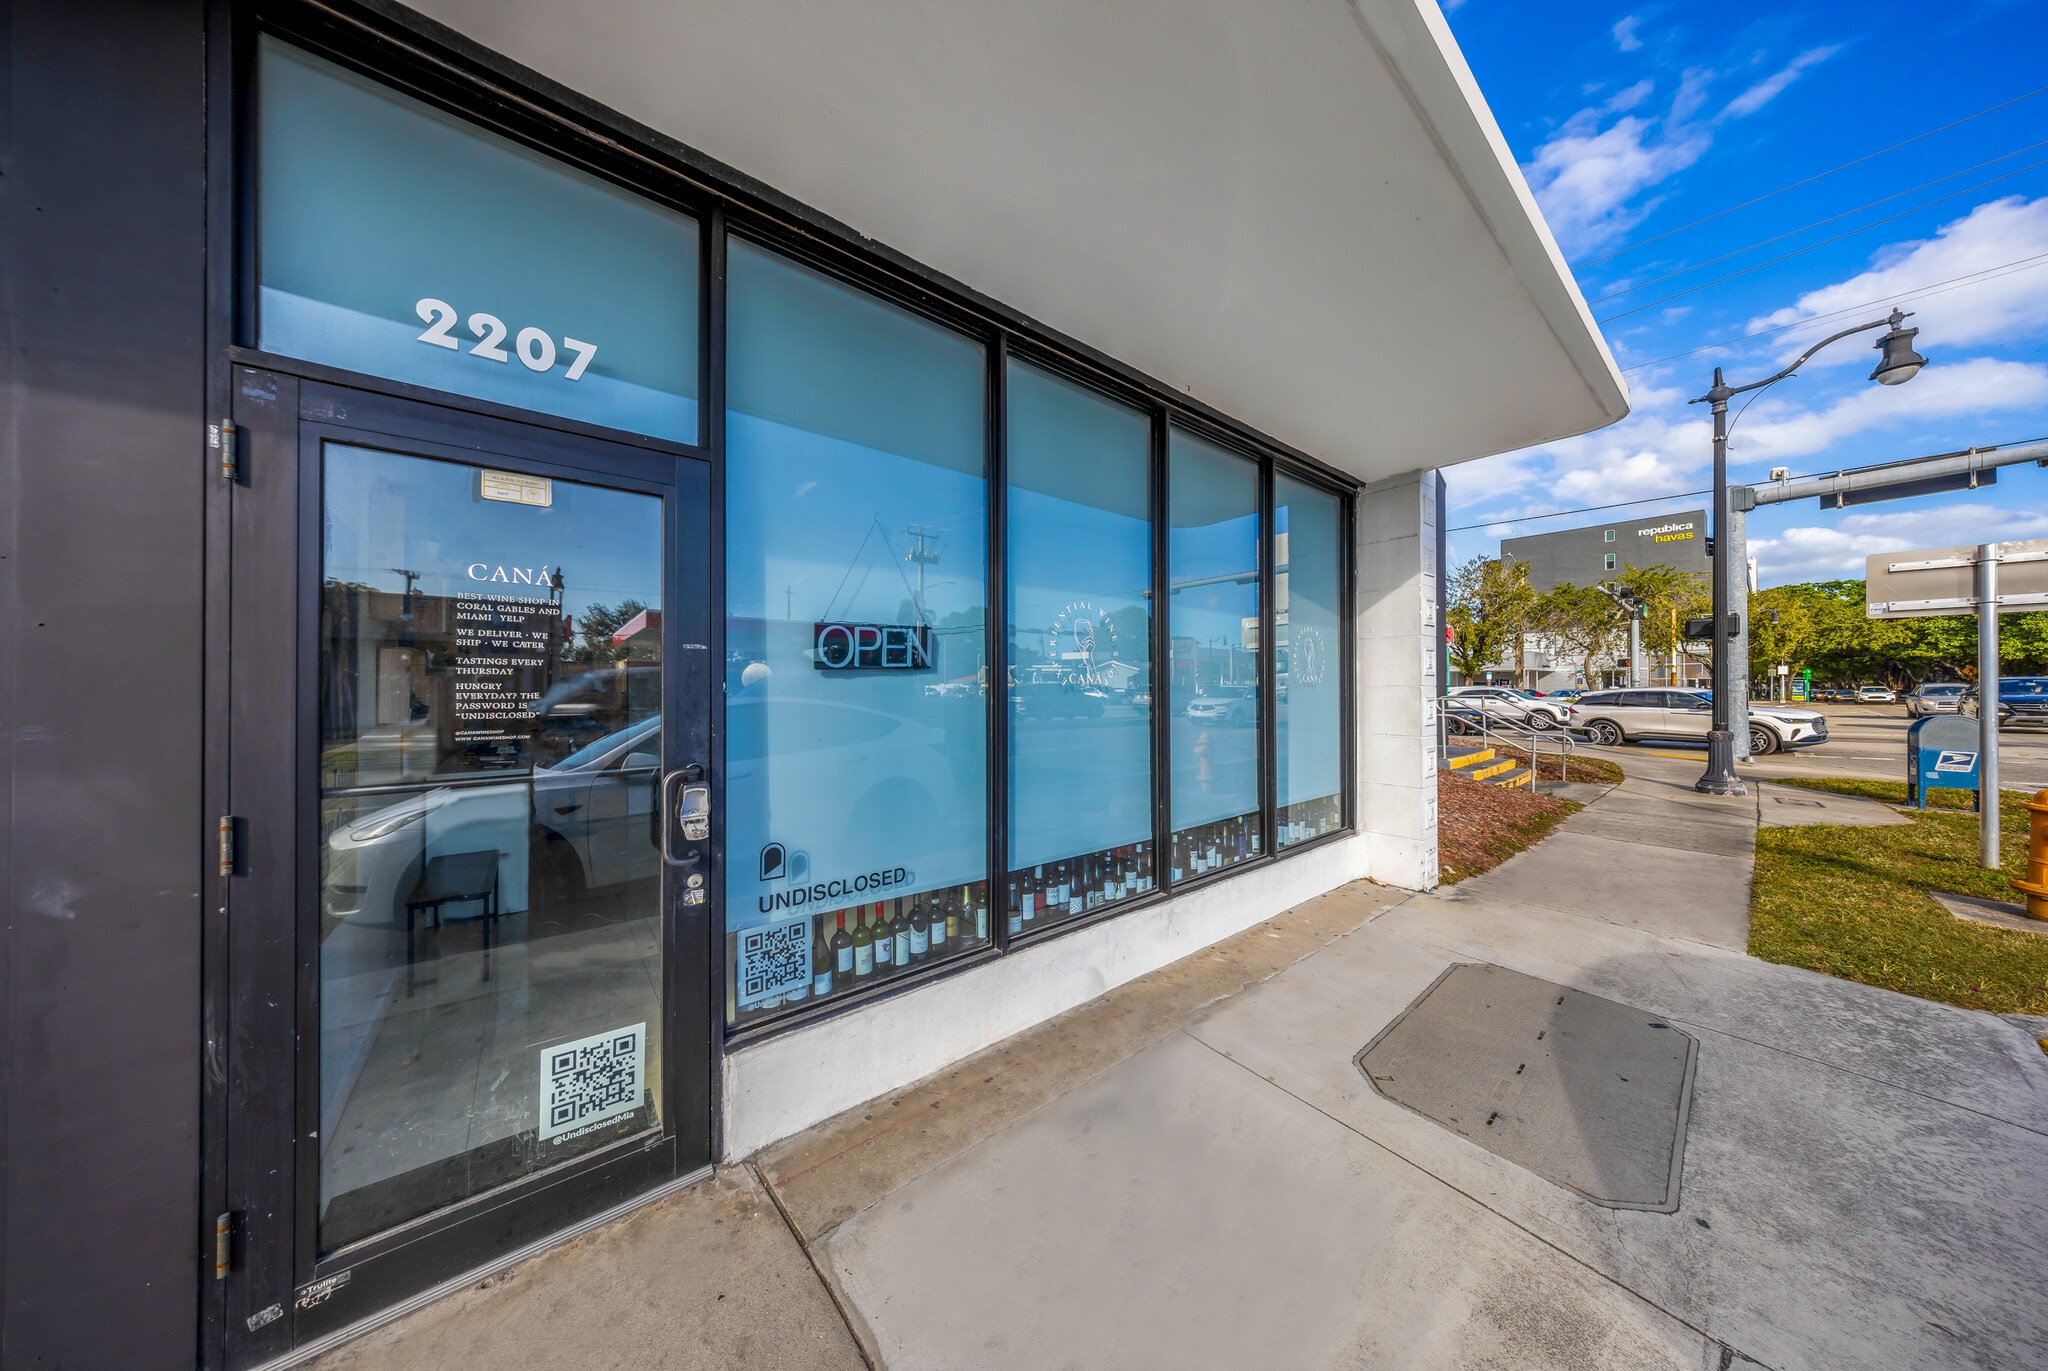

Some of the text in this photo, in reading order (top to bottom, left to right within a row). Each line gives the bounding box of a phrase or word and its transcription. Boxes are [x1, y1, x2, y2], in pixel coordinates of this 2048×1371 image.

[415, 298, 598, 381] 2207
[491, 475, 515, 483] ALARM
[1638, 523, 1693, 536] republica
[1655, 532, 1693, 543] havas
[467, 563, 554, 587] CANÁ
[457, 592, 483, 600] BEST
[487, 594, 515, 603] WINE
[518, 597, 546, 605] SHOP
[456, 602, 494, 611] CORAL
[497, 605, 536, 614] GABLES
[456, 612, 525, 623] MIAMI YELP
[456, 628, 549, 640] WE DELIVER WE
[456, 639, 545, 649] SHIP WE CATER
[818, 625, 932, 668] OPEN
[455, 657, 544, 666] TASTINGS EVERY
[455, 667, 514, 675] THURSDAY
[455, 682, 502, 690] HUNGRY
[455, 692, 517, 700] EVERYDAY?
[455, 702, 515, 710] PASSWORD
[758, 867, 906, 914] UNDISCLOSED
[552, 1110, 635, 1146] @UndisclosedMia
